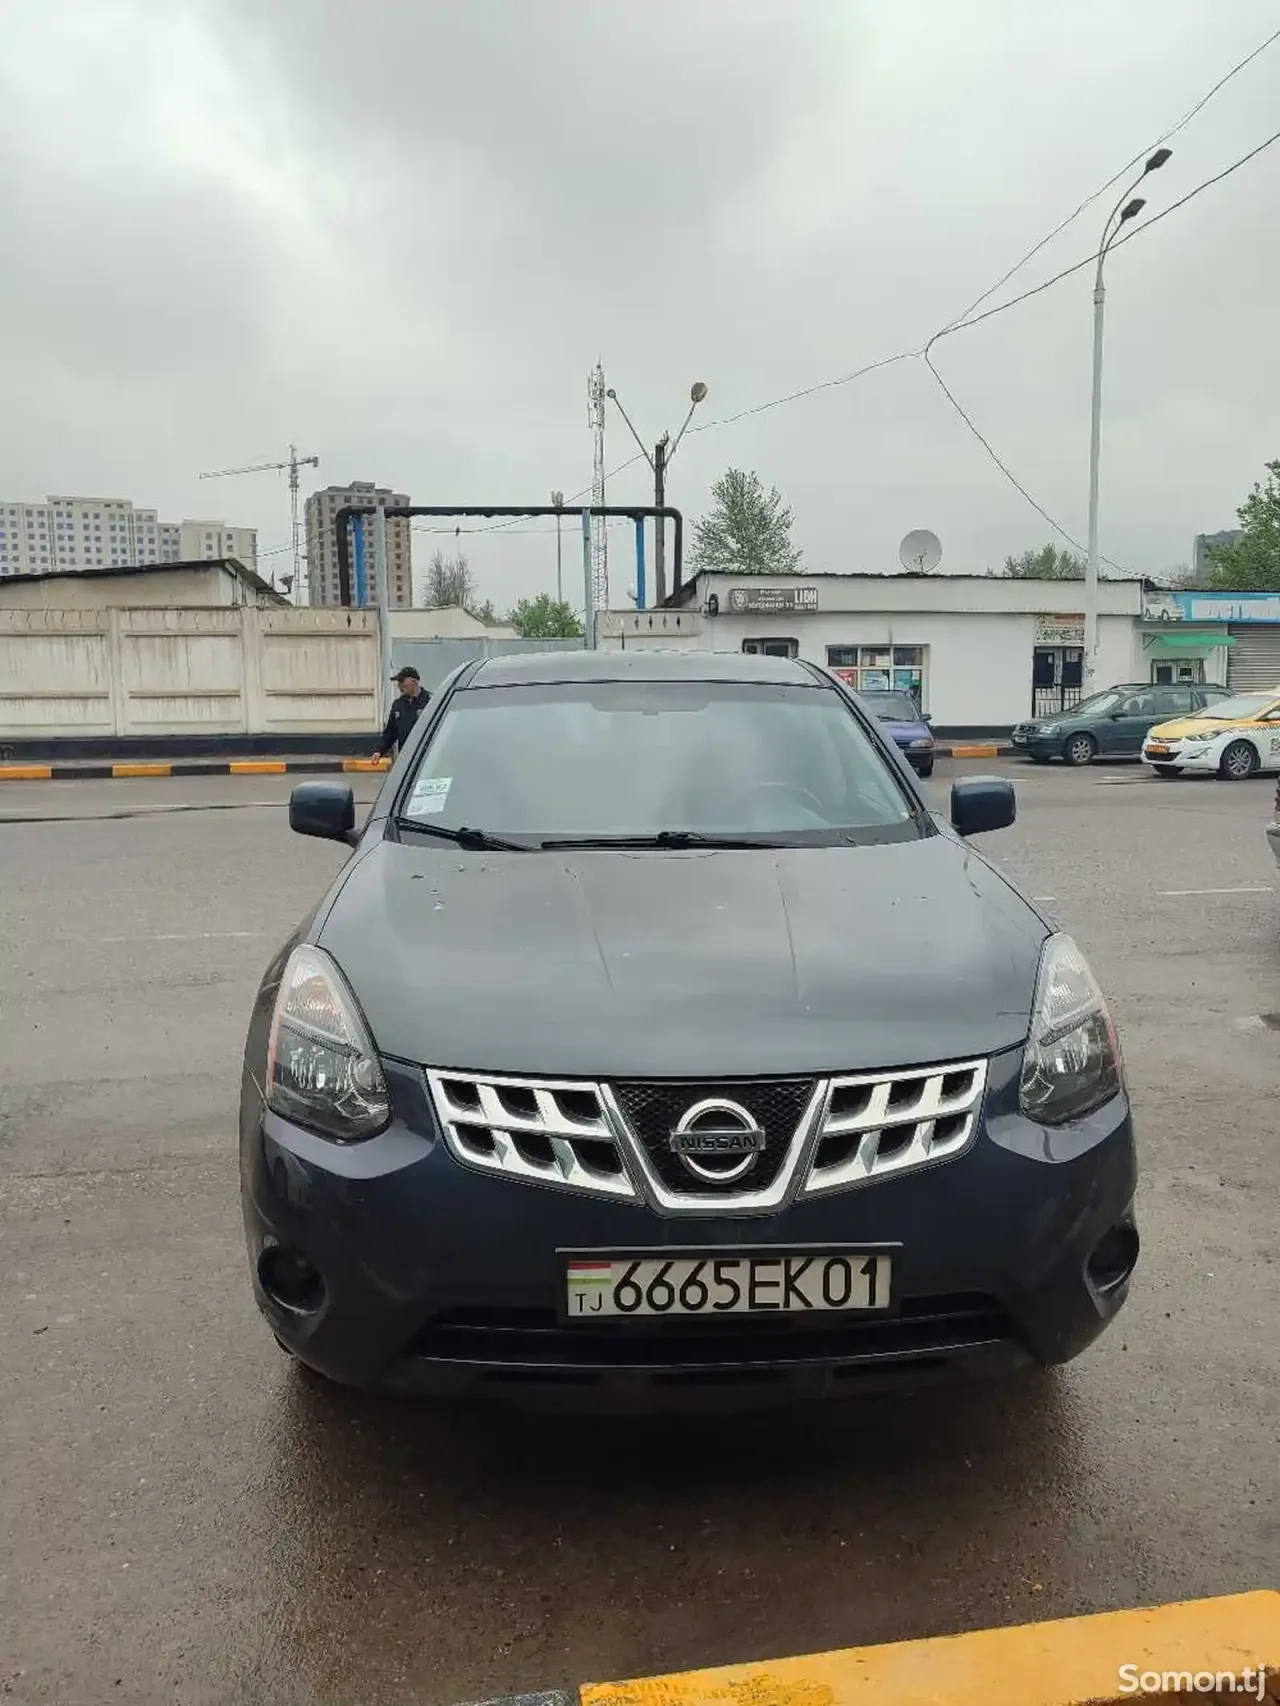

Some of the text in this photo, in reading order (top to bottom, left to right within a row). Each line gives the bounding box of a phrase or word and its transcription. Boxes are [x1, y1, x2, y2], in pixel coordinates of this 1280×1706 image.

[680, 1136, 757, 1150] NISSAN
[613, 1257, 877, 1312] 6665EK01
[575, 1292, 602, 1312] TJ
